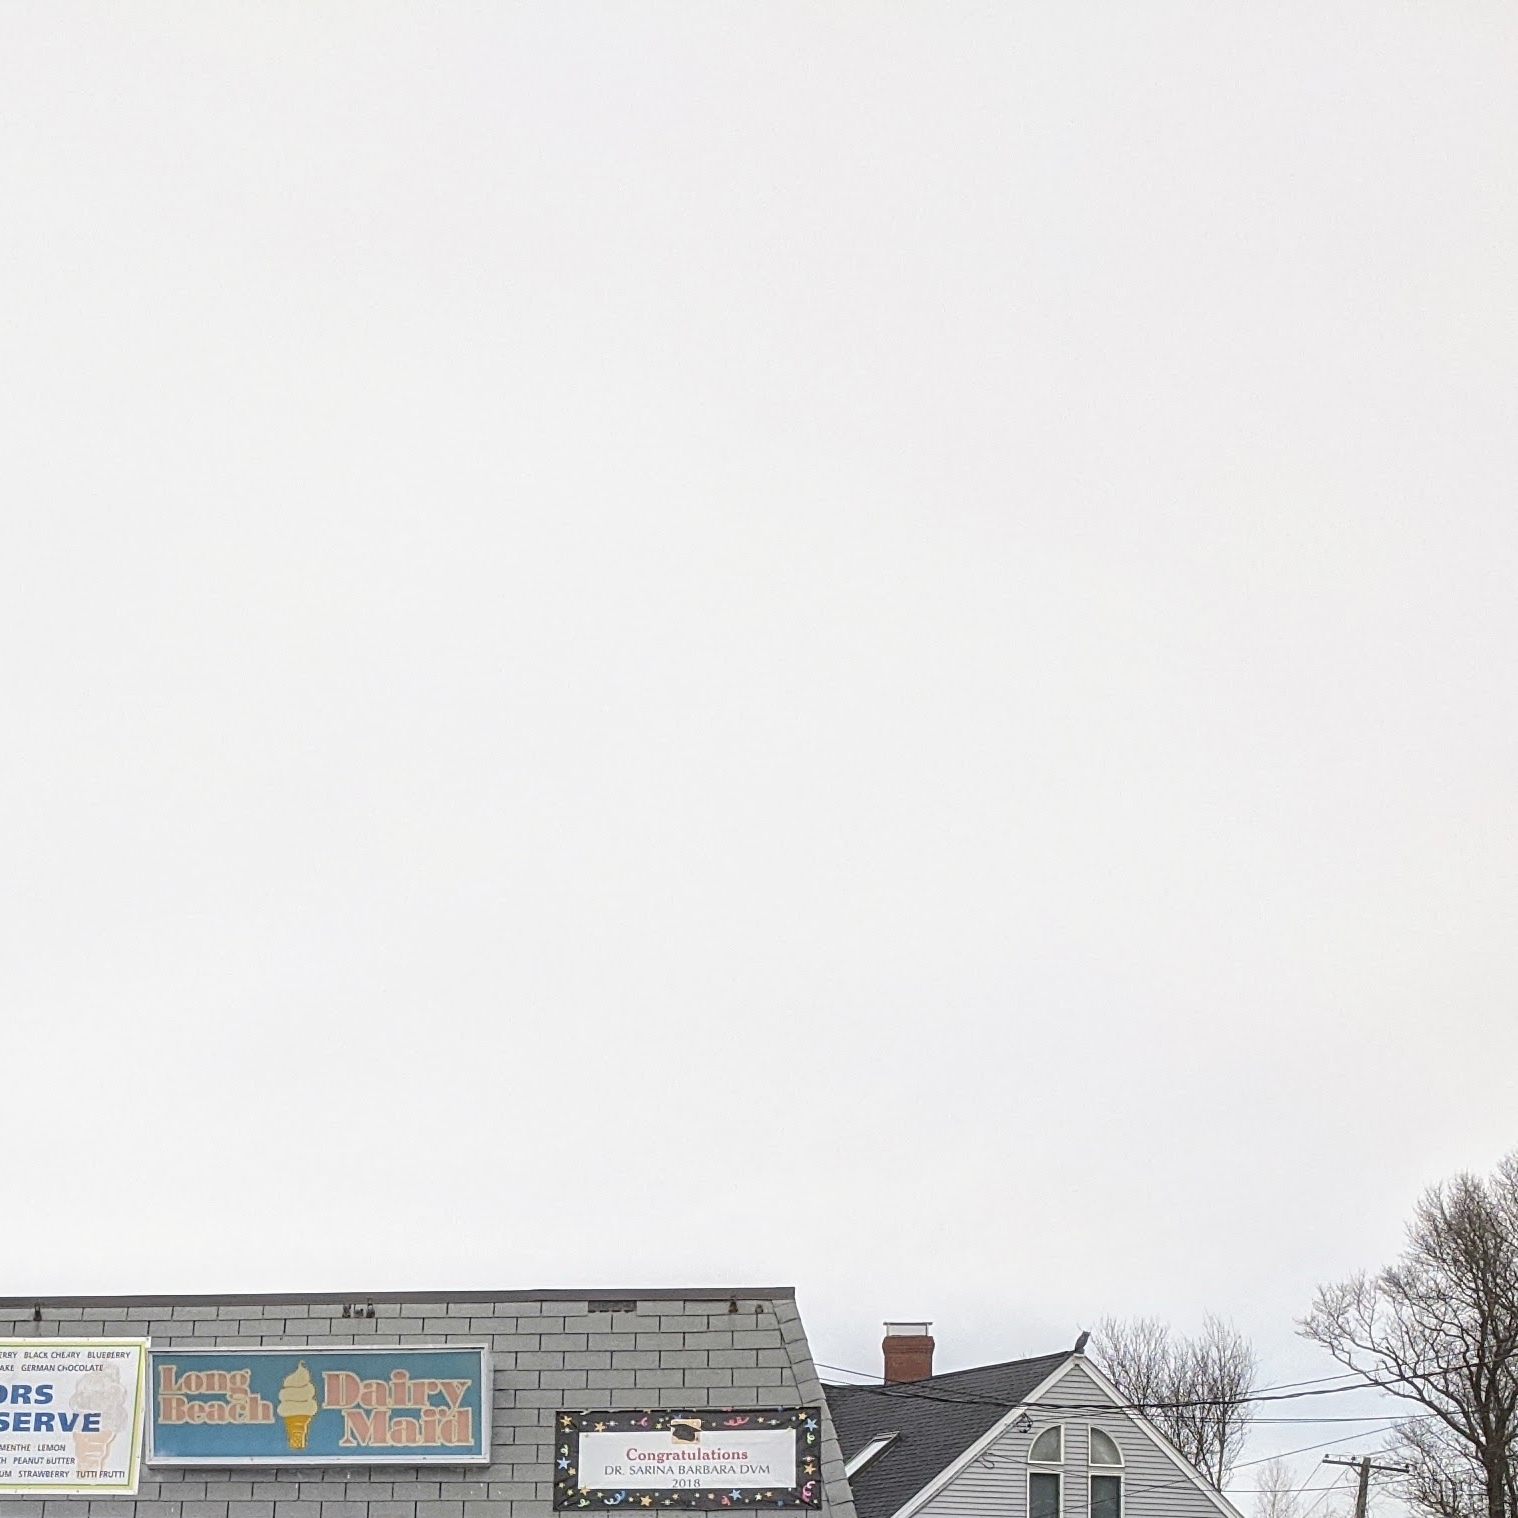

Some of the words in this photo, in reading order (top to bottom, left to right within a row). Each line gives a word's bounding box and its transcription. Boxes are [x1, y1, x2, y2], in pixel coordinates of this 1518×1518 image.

[158, 1364, 251, 1399] Long
[322, 1369, 472, 1418] Dairy
[158, 1393, 275, 1425] Beach
[339, 1407, 475, 1447] Maid
[0, 1444, 31, 1452] MENTHE
[37, 1444, 66, 1452] LEMON
[626, 1448, 748, 1463] Congratulations
[18, 1470, 70, 1478] STRAWBERRY
[76, 1470, 97, 1478] TUTTI
[99, 1470, 125, 1478] FRUTTI
[604, 1465, 625, 1476] DR.
[629, 1465, 674, 1475] SARINA
[678, 1465, 736, 1475] BARBARA
[740, 1464, 771, 1475] DVM
[672, 1478, 701, 1489] 2018
